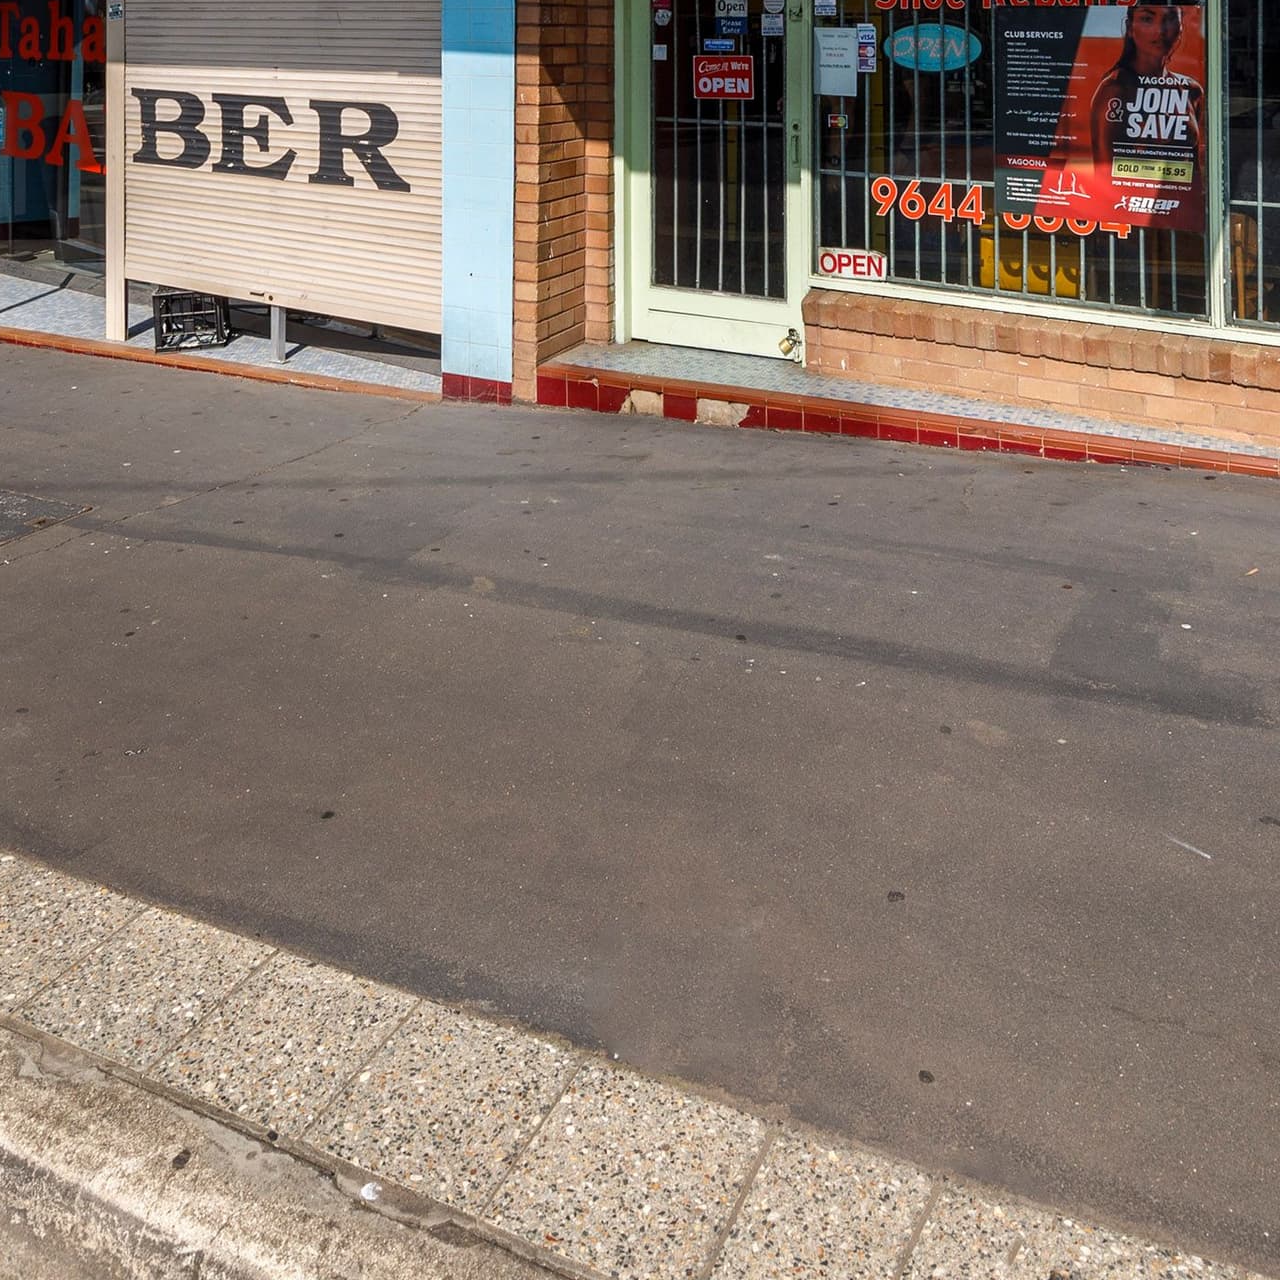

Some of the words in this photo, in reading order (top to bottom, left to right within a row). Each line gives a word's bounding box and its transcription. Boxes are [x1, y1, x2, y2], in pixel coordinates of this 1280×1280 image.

[717, 0, 745, 14] Open
[860, 33, 874, 41] VISA
[1026, 31, 1064, 39] SERVICES
[894, 36, 967, 58] OPEN
[730, 61, 749, 70] We're
[698, 77, 749, 93] OPEN
[1138, 76, 1190, 86] YAGOONA
[1126, 88, 1189, 114] JOIN
[1105, 97, 1123, 122] &
[0, 90, 107, 175] BA
[1126, 113, 1190, 141] SAVE
[131, 87, 411, 193] BER
[1007, 158, 1047, 167] YAGOONA
[1117, 164, 1139, 173] GOLD
[1158, 166, 1187, 176] $15.95
[871, 176, 985, 225] 9644
[1128, 196, 1180, 211] snap
[820, 252, 882, 277] OPEN
